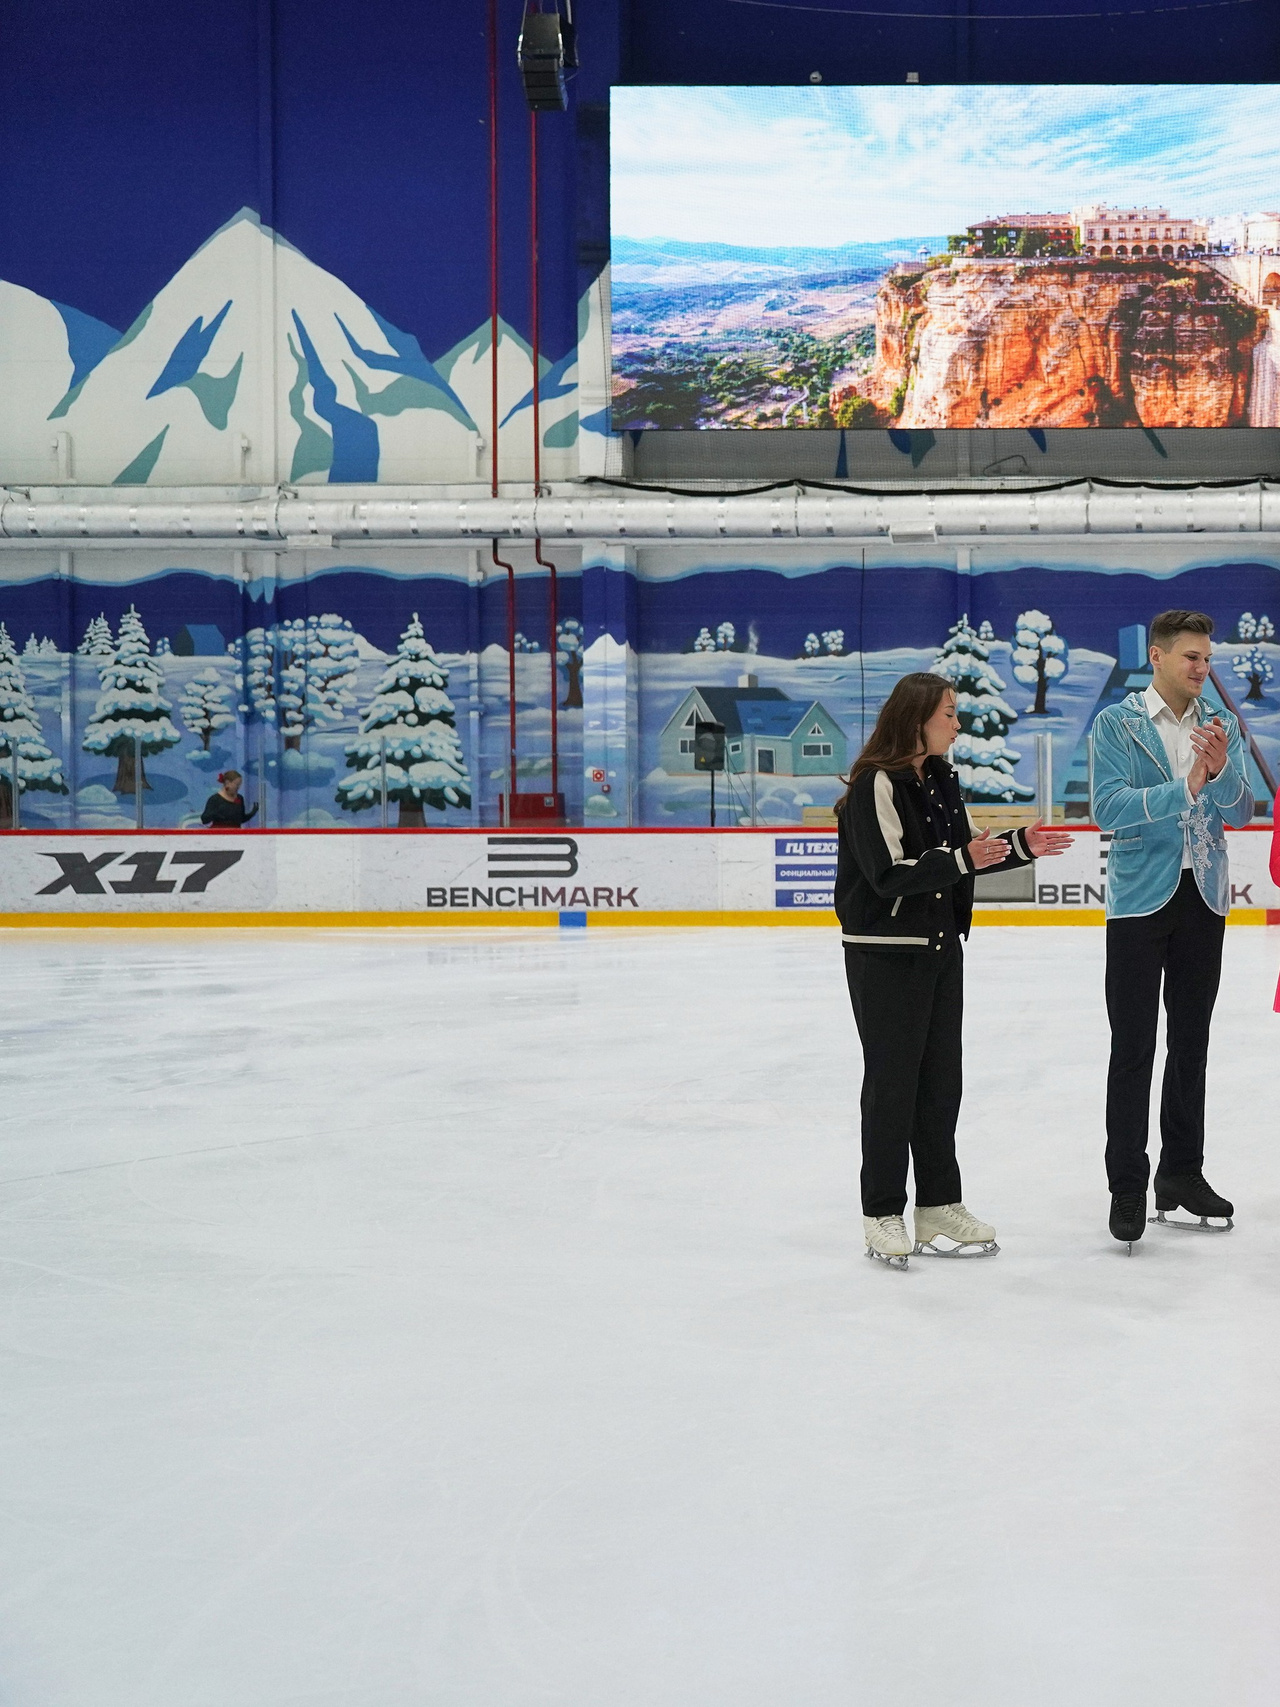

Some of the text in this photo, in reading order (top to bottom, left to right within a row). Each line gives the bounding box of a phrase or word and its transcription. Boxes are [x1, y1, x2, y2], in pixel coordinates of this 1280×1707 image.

[785, 842, 838, 855] ГЦ ТЕХ
[34, 849, 245, 895] X17
[780, 869, 835, 878] ОФИЦИАЛЬНЫЙ
[426, 886, 640, 908] BENCHMARK
[804, 893, 834, 904] XCM
